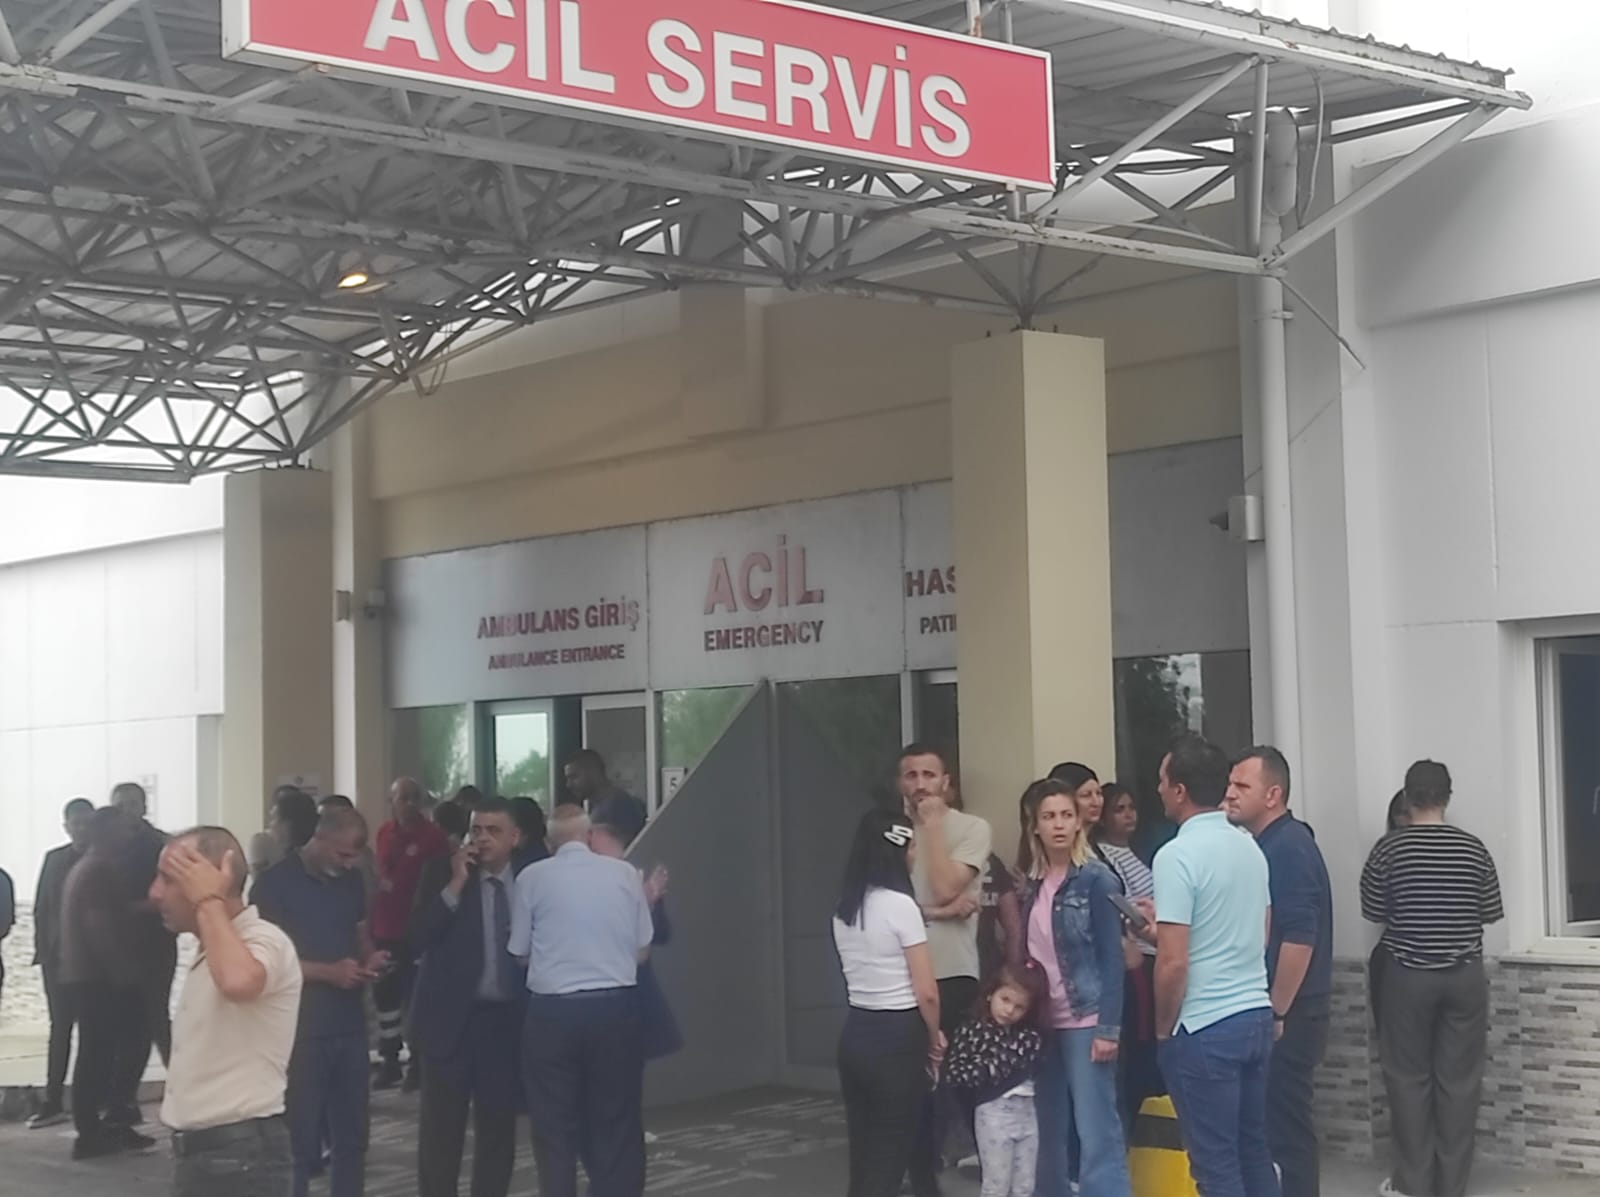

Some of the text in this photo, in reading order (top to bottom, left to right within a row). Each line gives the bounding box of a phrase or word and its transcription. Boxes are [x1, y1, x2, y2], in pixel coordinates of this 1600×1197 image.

[646, 18, 971, 158] SERVİS
[703, 534, 825, 616] ACİL
[477, 597, 640, 640] AMBULANS GİRİŞ
[703, 620, 825, 652] EMERGENCY
[919, 614, 958, 635] PATI
[560, 644, 626, 664] ENTRANCE
